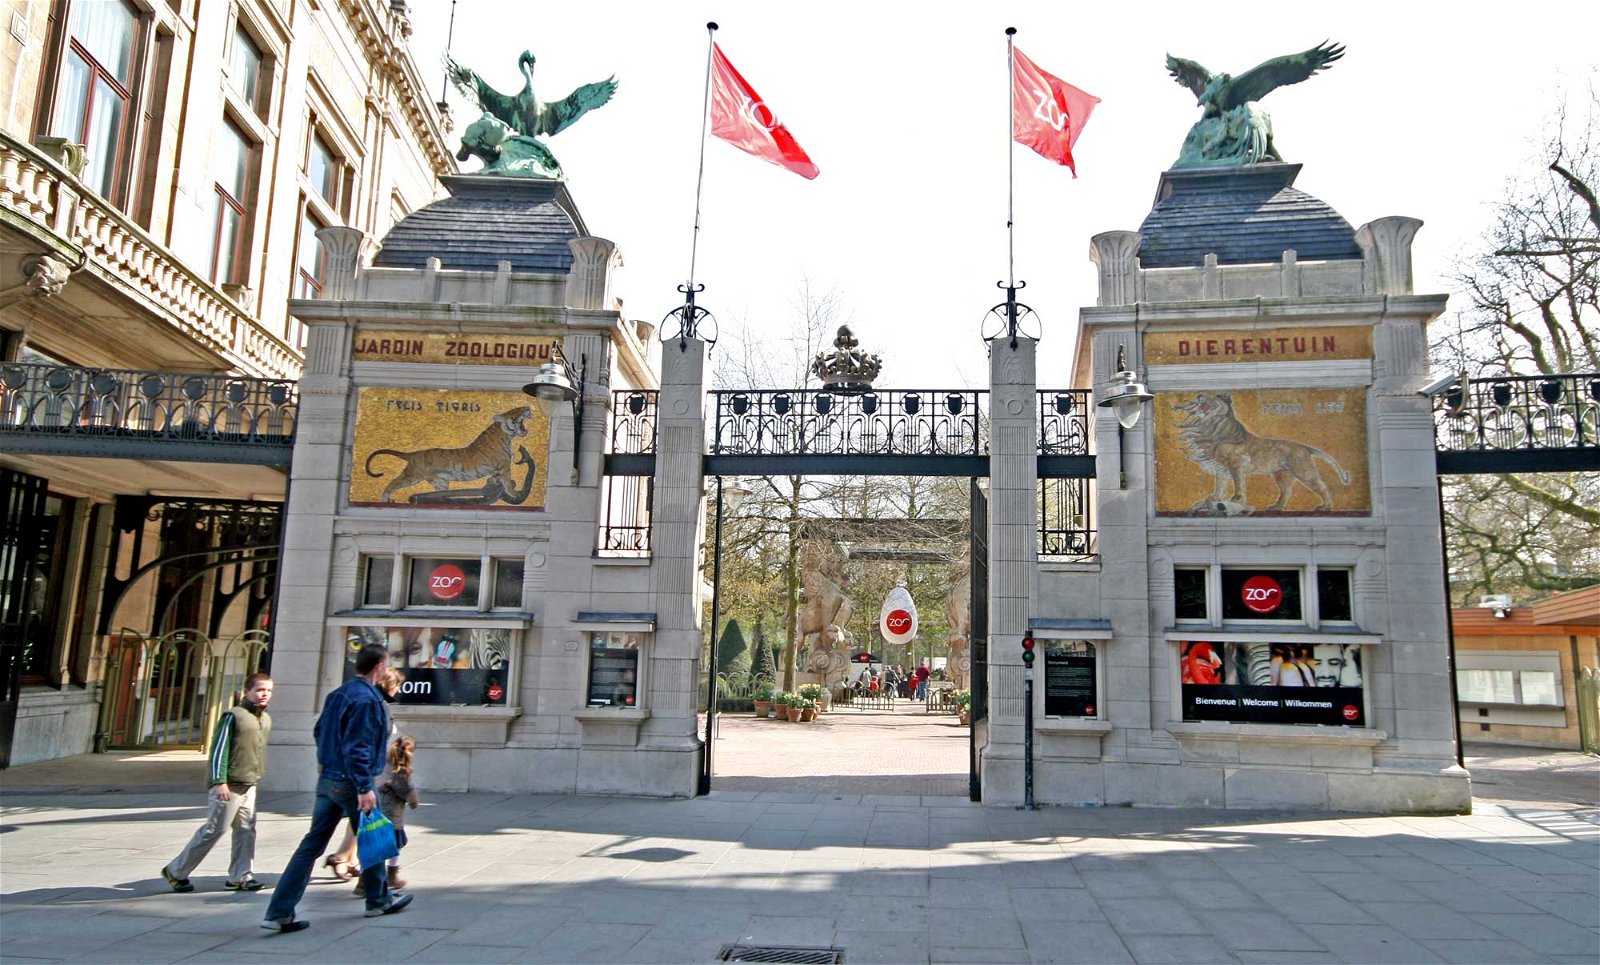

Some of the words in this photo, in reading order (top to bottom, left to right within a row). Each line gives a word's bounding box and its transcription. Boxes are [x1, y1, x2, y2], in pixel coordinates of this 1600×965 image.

[355, 338, 424, 356] JARDIN
[444, 341, 551, 360] ZOOLOGIQU
[1178, 335, 1336, 357] DIERENTUIN
[1195, 697, 1237, 706] Bienvenue
[1242, 698, 1279, 707] Welcome
